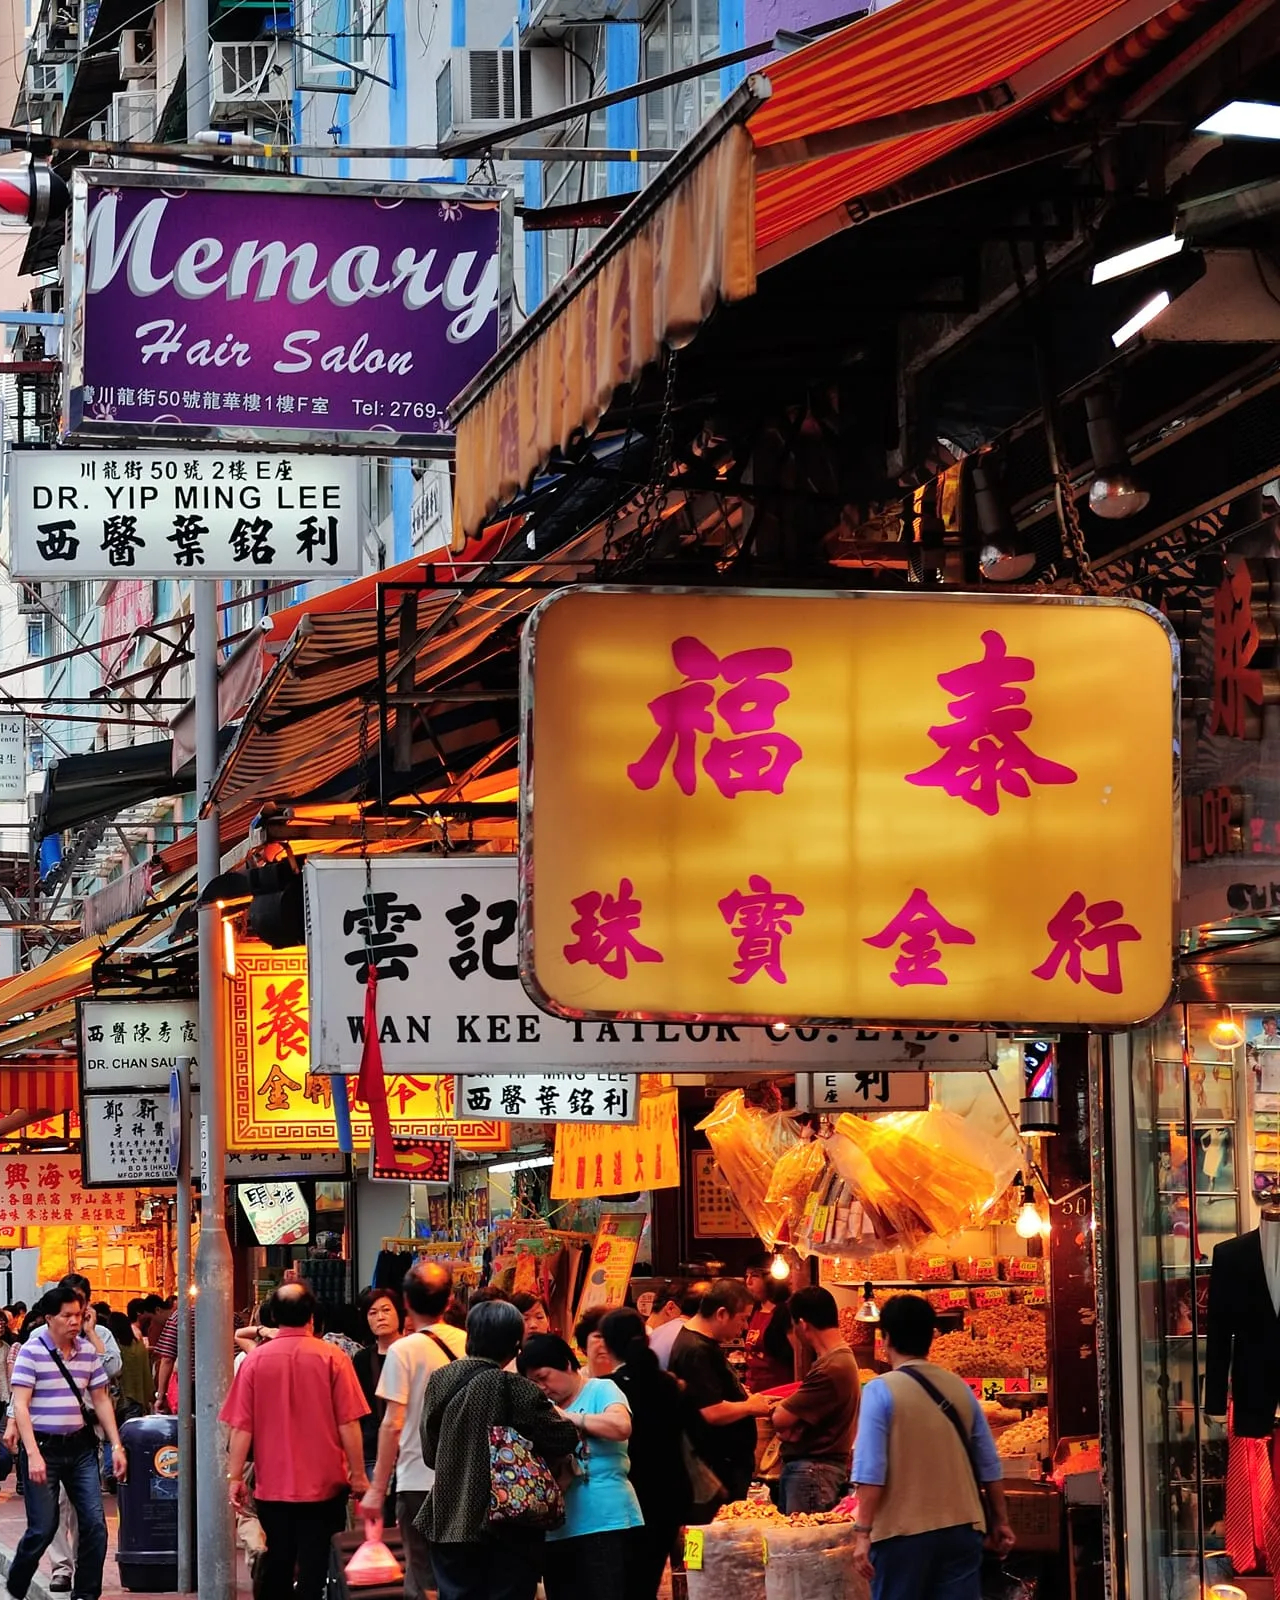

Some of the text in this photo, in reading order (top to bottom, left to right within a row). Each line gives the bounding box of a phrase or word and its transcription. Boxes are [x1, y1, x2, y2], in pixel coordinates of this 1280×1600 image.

[85, 195, 499, 343] Memory
[135, 319, 414, 375] Hair Salon
[352, 399, 385, 416] Tel:
[33, 486, 342, 509] DR. YIP MING LEE
[36, 515, 339, 567] 西醫葉銘利
[563, 875, 1142, 995] 珠寶金行
[87, 1020, 198, 1045] 西醫陳秀霞
[347, 1016, 431, 1043] WAN
[457, 1015, 542, 1043] KEE
[88, 1059, 109, 1070] DR.
[112, 1057, 147, 1069] CHAN
[466, 1084, 629, 1118] 西醫葉銘利
